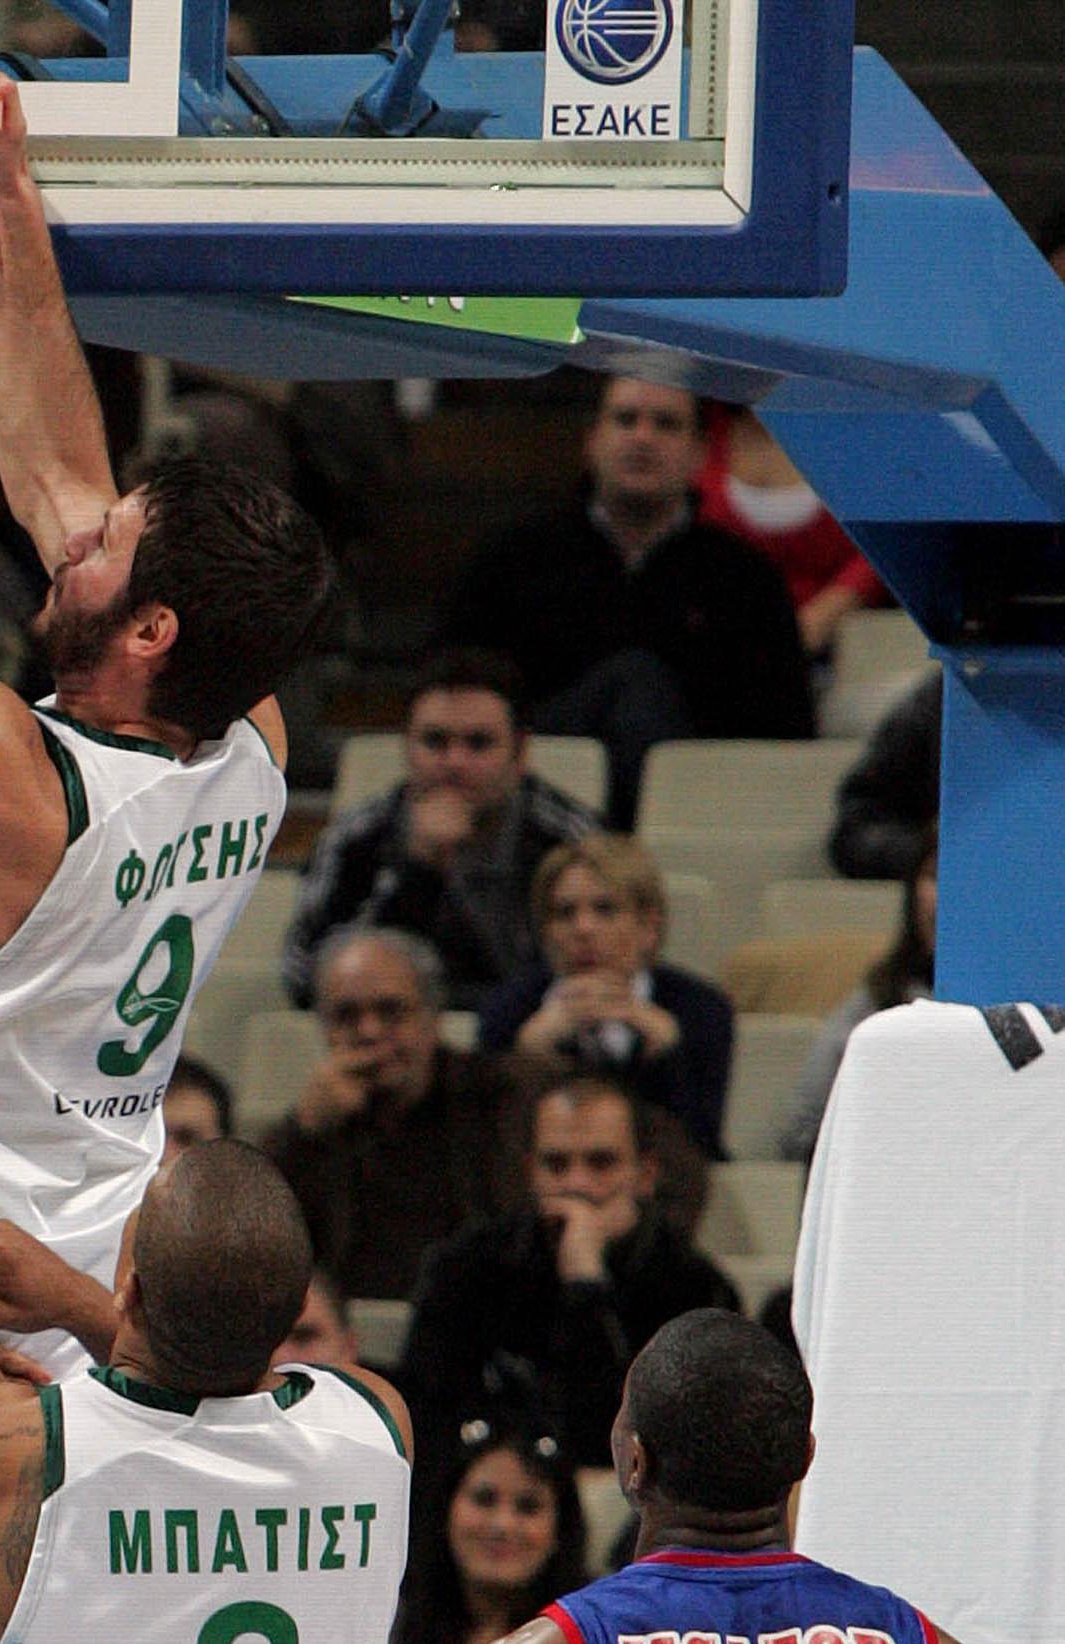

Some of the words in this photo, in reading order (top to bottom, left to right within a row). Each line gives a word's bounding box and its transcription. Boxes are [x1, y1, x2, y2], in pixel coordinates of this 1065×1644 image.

[551, 103, 672, 136] ΕΣΑΚΕ
[96, 913, 195, 1077] 9
[108, 1502, 378, 1575] ΜΠΑΤΙΣΤ
